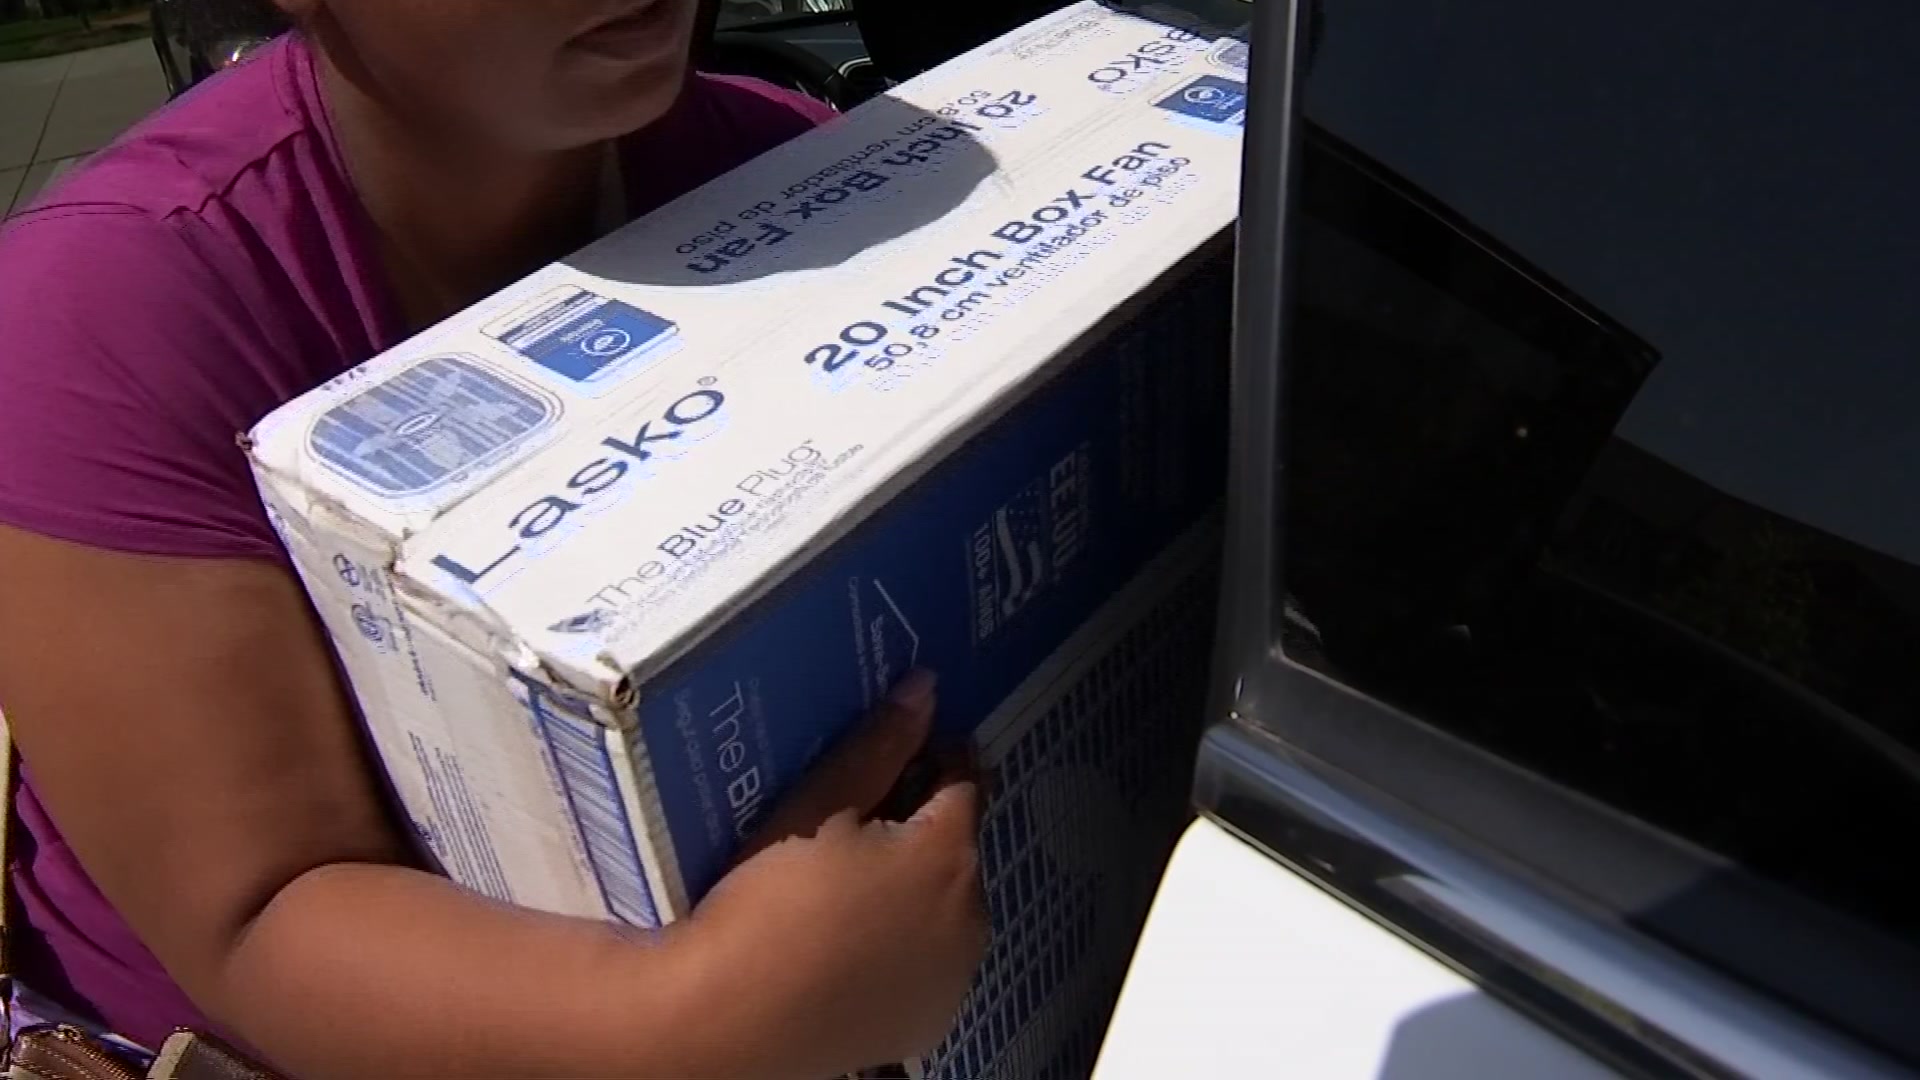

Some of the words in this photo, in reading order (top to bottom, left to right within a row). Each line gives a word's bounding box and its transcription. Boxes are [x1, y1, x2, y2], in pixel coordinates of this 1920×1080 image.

[896, 116, 937, 137] cm
[975, 90, 1037, 118] 20
[881, 120, 982, 166] Inch
[780, 137, 900, 200] ventilador
[738, 201, 777, 220] de
[784, 170, 890, 220] Box
[676, 221, 738, 255] piso
[685, 223, 794, 274] Fan
[804, 321, 889, 373] 20
[881, 249, 1004, 316] Inch
[990, 189, 1097, 244] Box
[1079, 142, 1171, 185] Fan
[864, 323, 940, 371] 50,8
[941, 290, 992, 321] cm
[984, 209, 1109, 287] ventilador
[1108, 187, 1144, 208] de
[1141, 156, 1191, 187] piso
[585, 560, 665, 607] The
[656, 498, 745, 557] Blue
[708, 680, 746, 773] The
[727, 765, 765, 839] Blu
